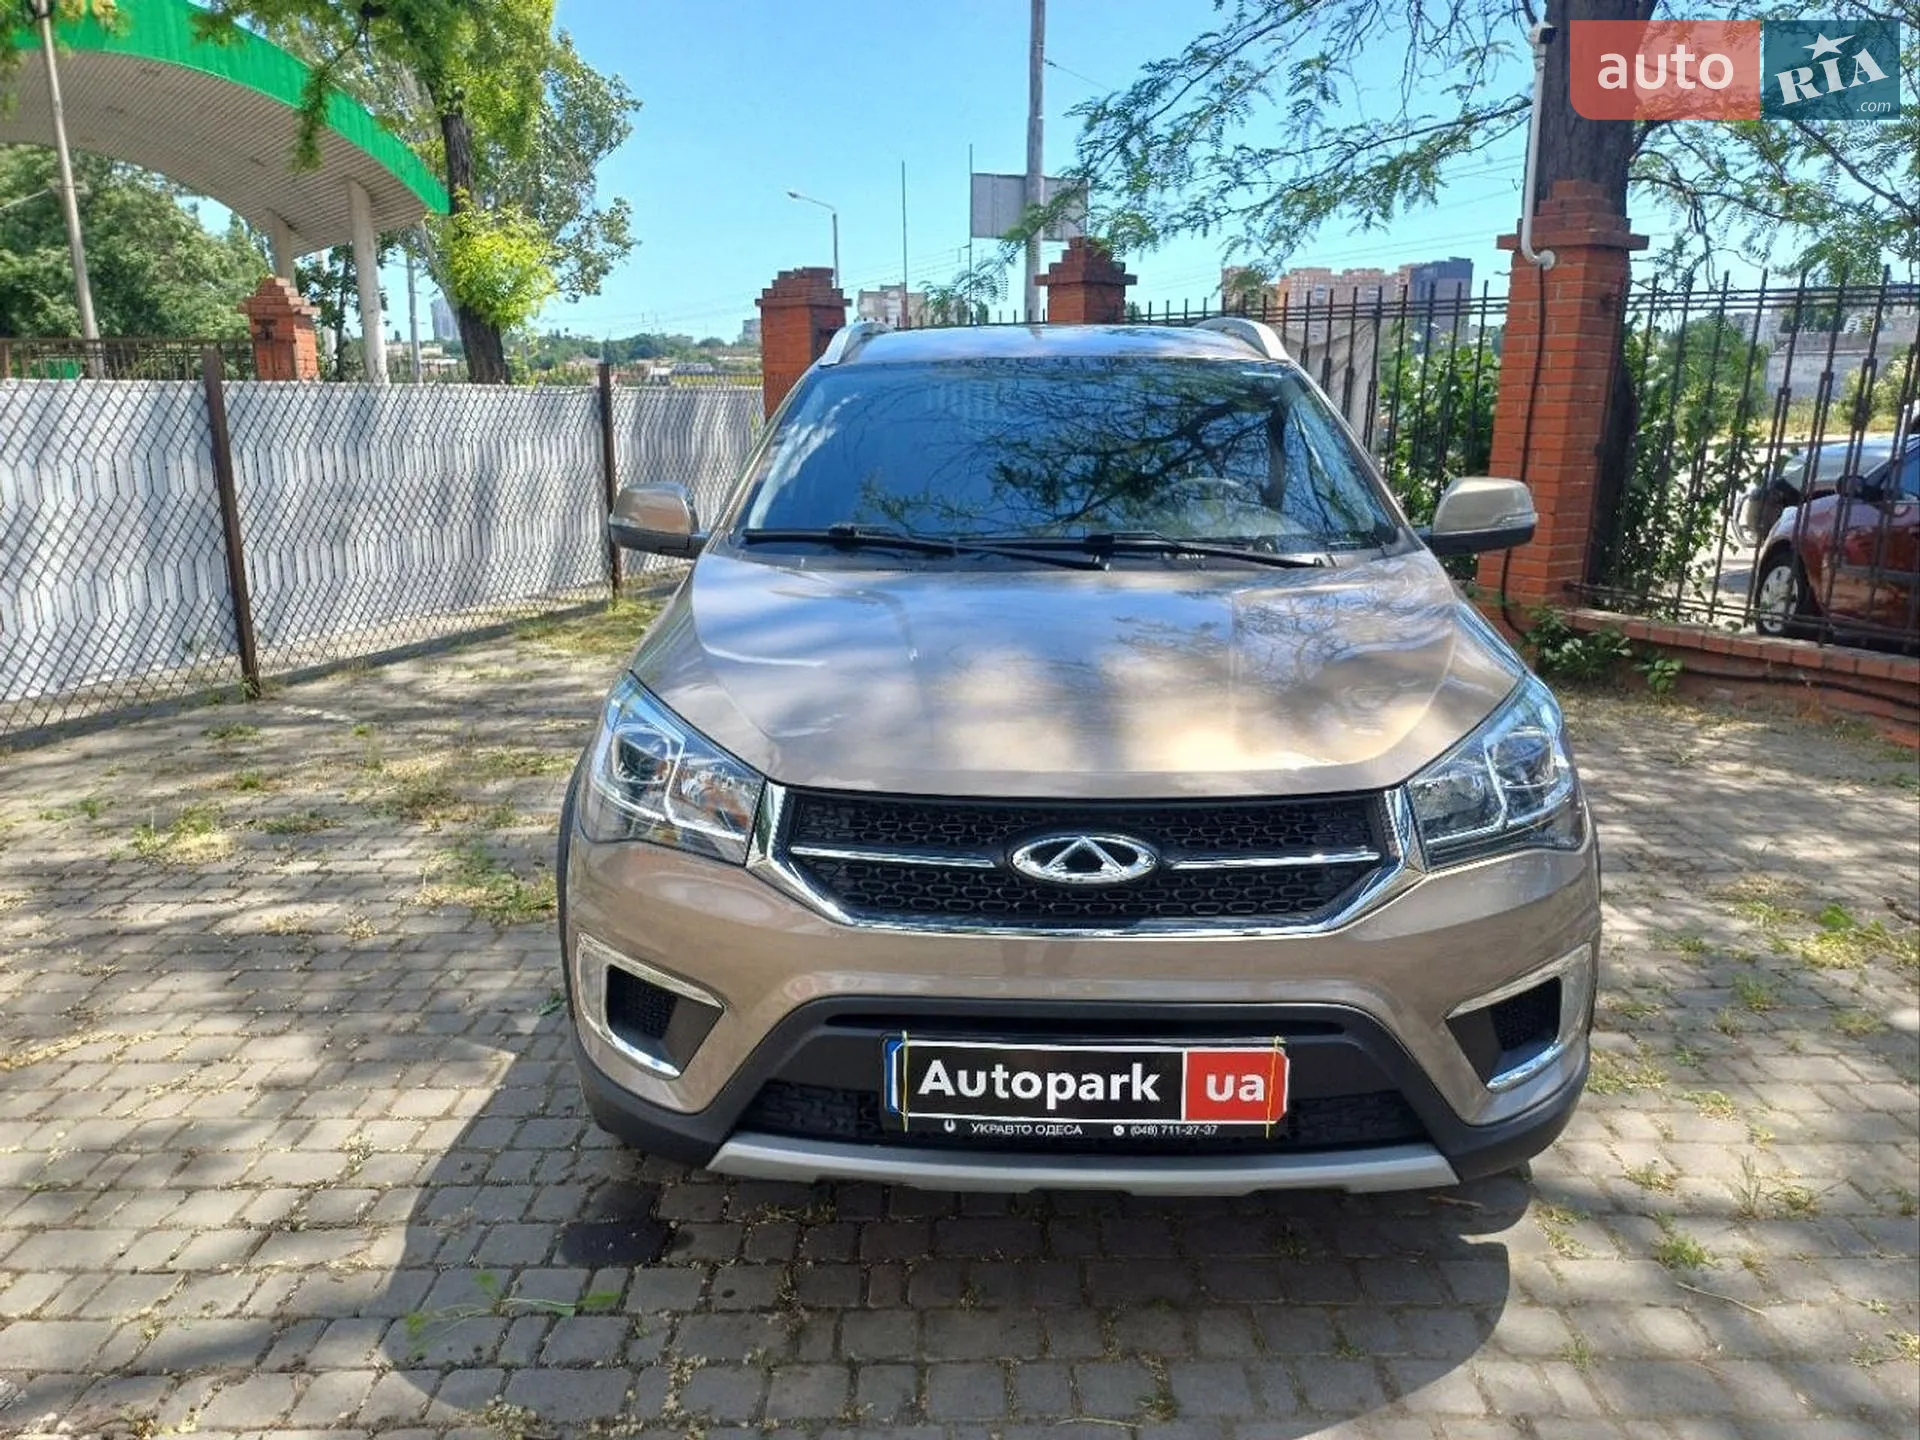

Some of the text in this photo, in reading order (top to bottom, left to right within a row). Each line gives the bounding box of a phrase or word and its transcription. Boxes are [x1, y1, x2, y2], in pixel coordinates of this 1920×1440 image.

[918, 1059, 1265, 1110] Autopark ua
[970, 1123, 1083, 1136] УКРАВТО ОДЕСА
